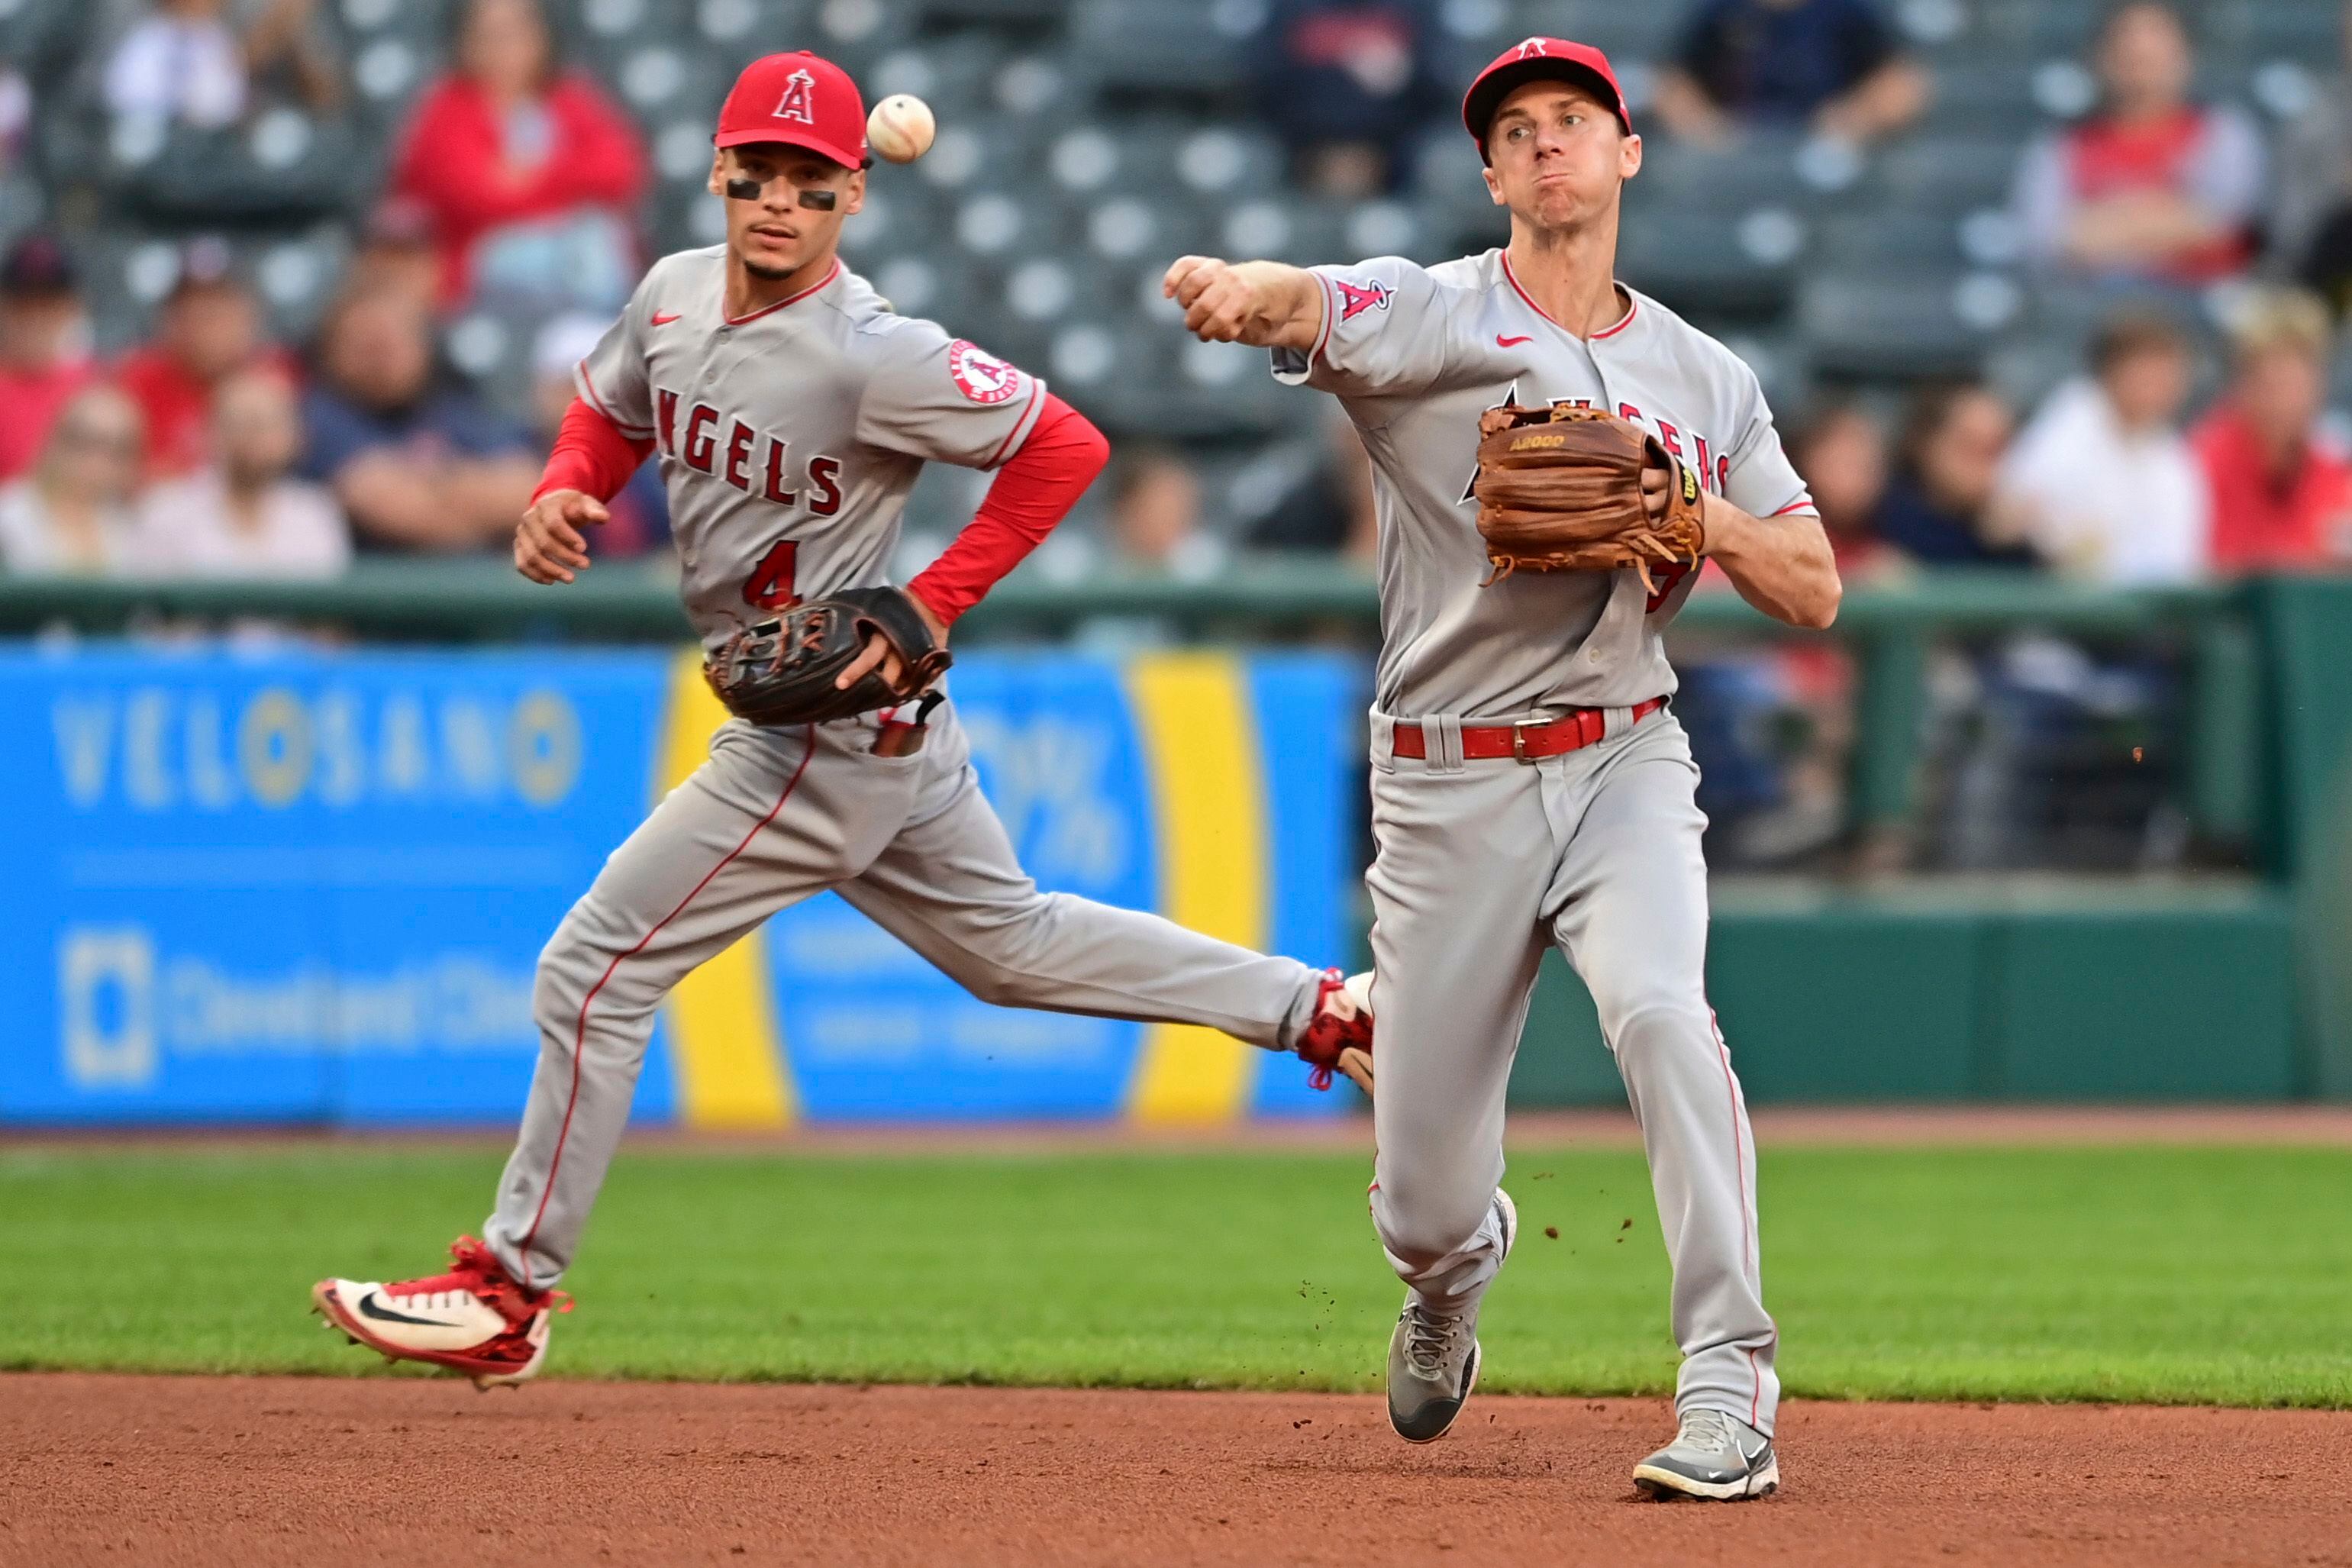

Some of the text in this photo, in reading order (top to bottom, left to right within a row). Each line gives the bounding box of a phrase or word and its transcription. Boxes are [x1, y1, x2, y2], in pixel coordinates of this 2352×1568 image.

[657, 386, 842, 518] NGELS
[1509, 434, 1565, 452] A2000
[742, 539, 803, 611] 4
